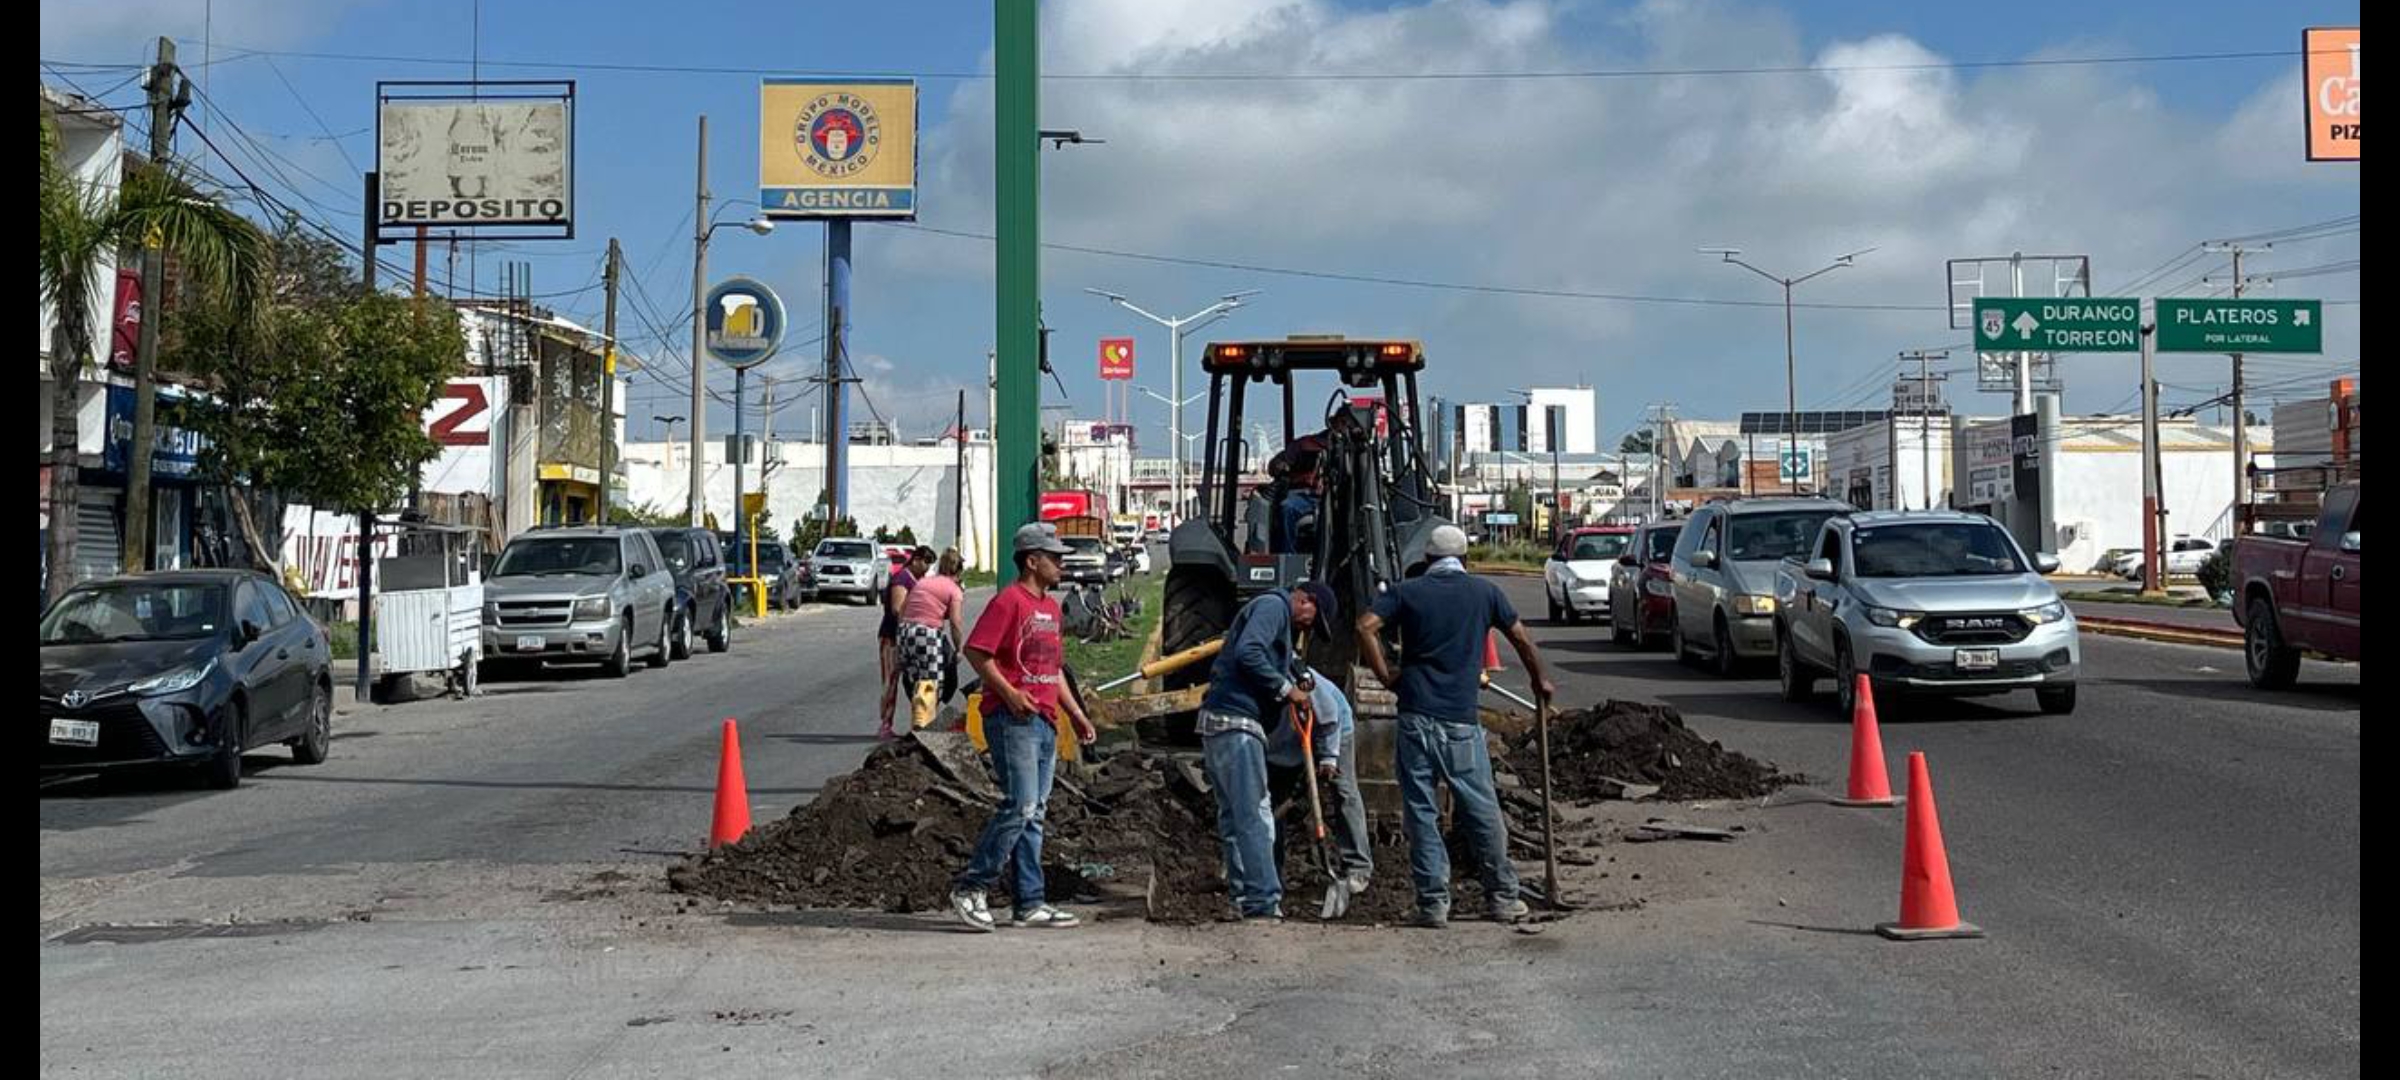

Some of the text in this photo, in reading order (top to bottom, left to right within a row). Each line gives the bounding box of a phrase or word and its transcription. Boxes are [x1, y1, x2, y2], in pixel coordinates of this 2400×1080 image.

[796, 95, 878, 146] GRUPO MODELO
[783, 190, 890, 208] AGENCIA
[384, 198, 563, 219] DEPOSITO
[2043, 305, 2135, 321] DURANGO
[2176, 308, 2279, 325] PLATEROS
[1984, 319, 2001, 334] 45
[2044, 329, 2135, 345] TORREON
[2204, 333, 2272, 343] POR LATERAL
[1946, 619, 2003, 630] RAM
